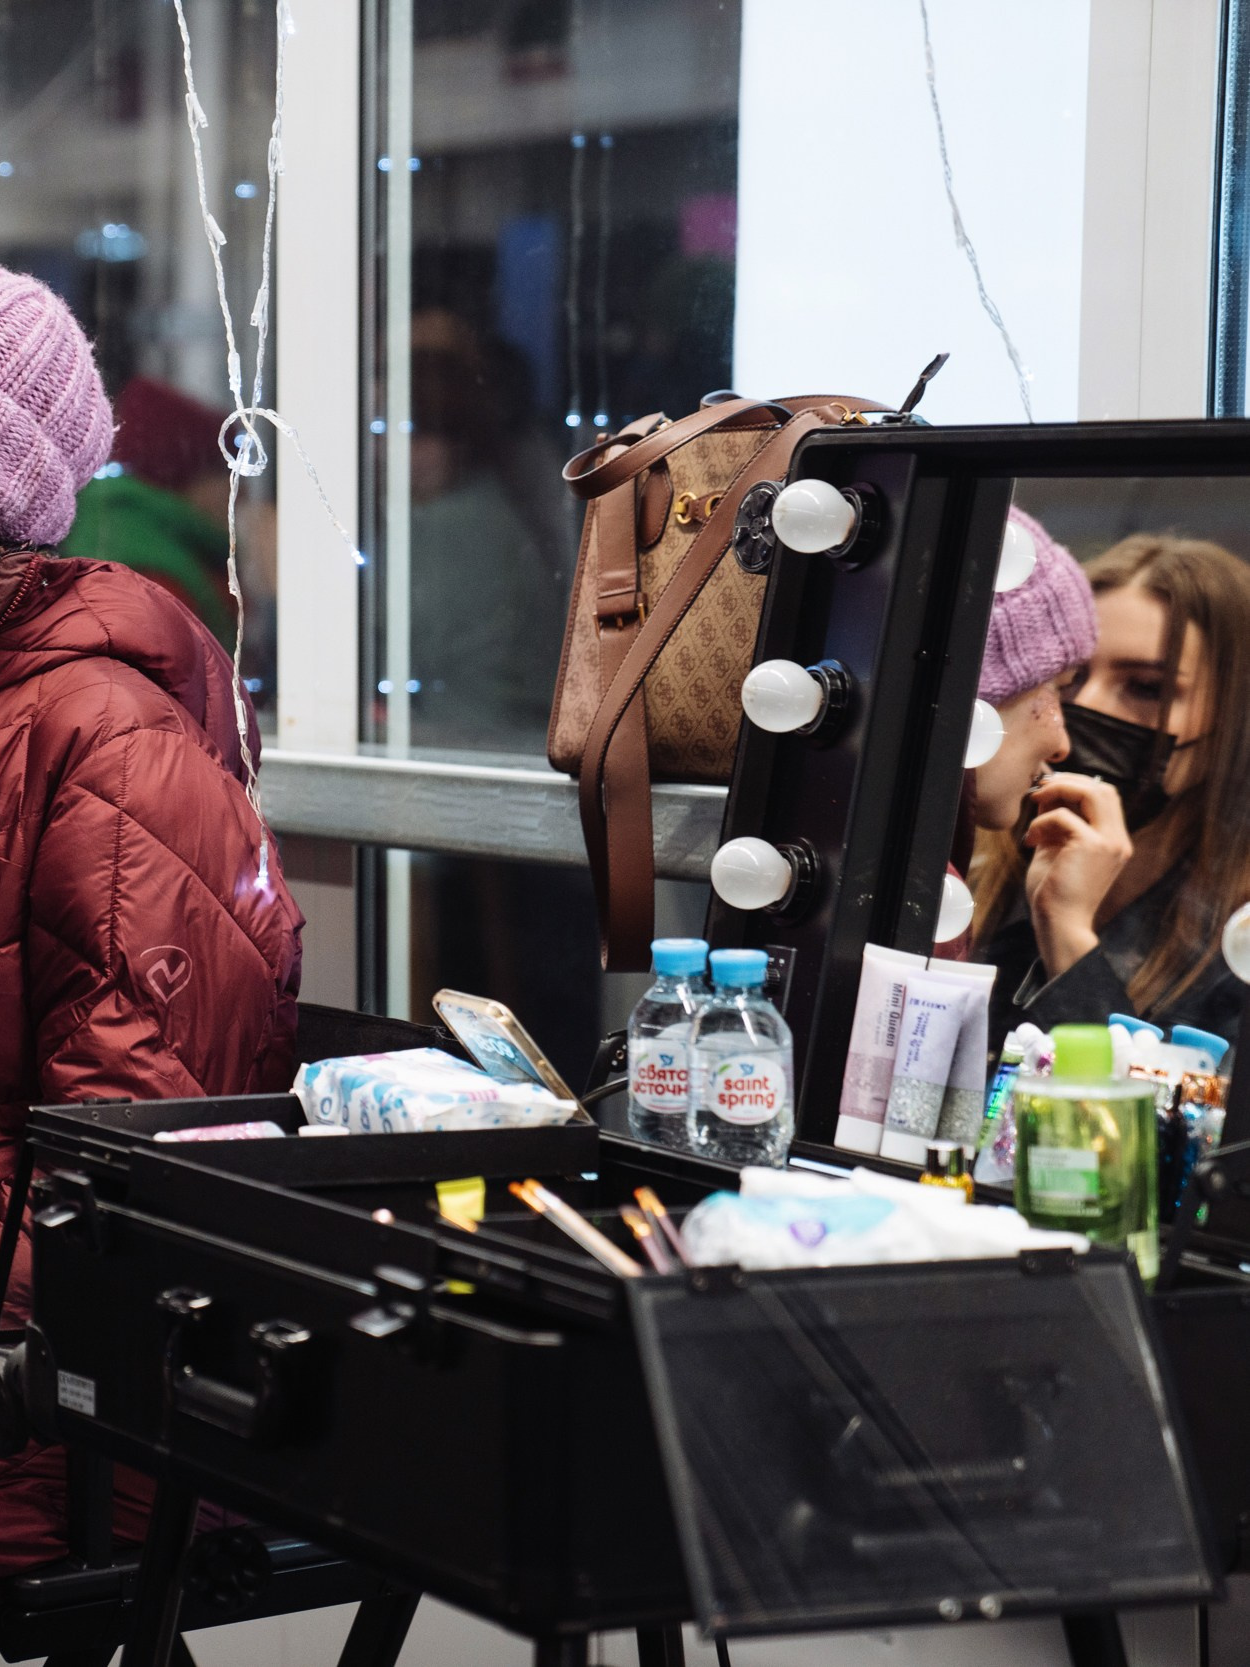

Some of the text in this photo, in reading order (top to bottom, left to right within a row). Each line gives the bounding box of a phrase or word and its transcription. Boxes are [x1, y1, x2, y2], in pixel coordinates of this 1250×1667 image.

[886, 983, 903, 1047] Mini Queen
[724, 1075, 770, 1092] saint
[718, 1091, 776, 1110] spring
